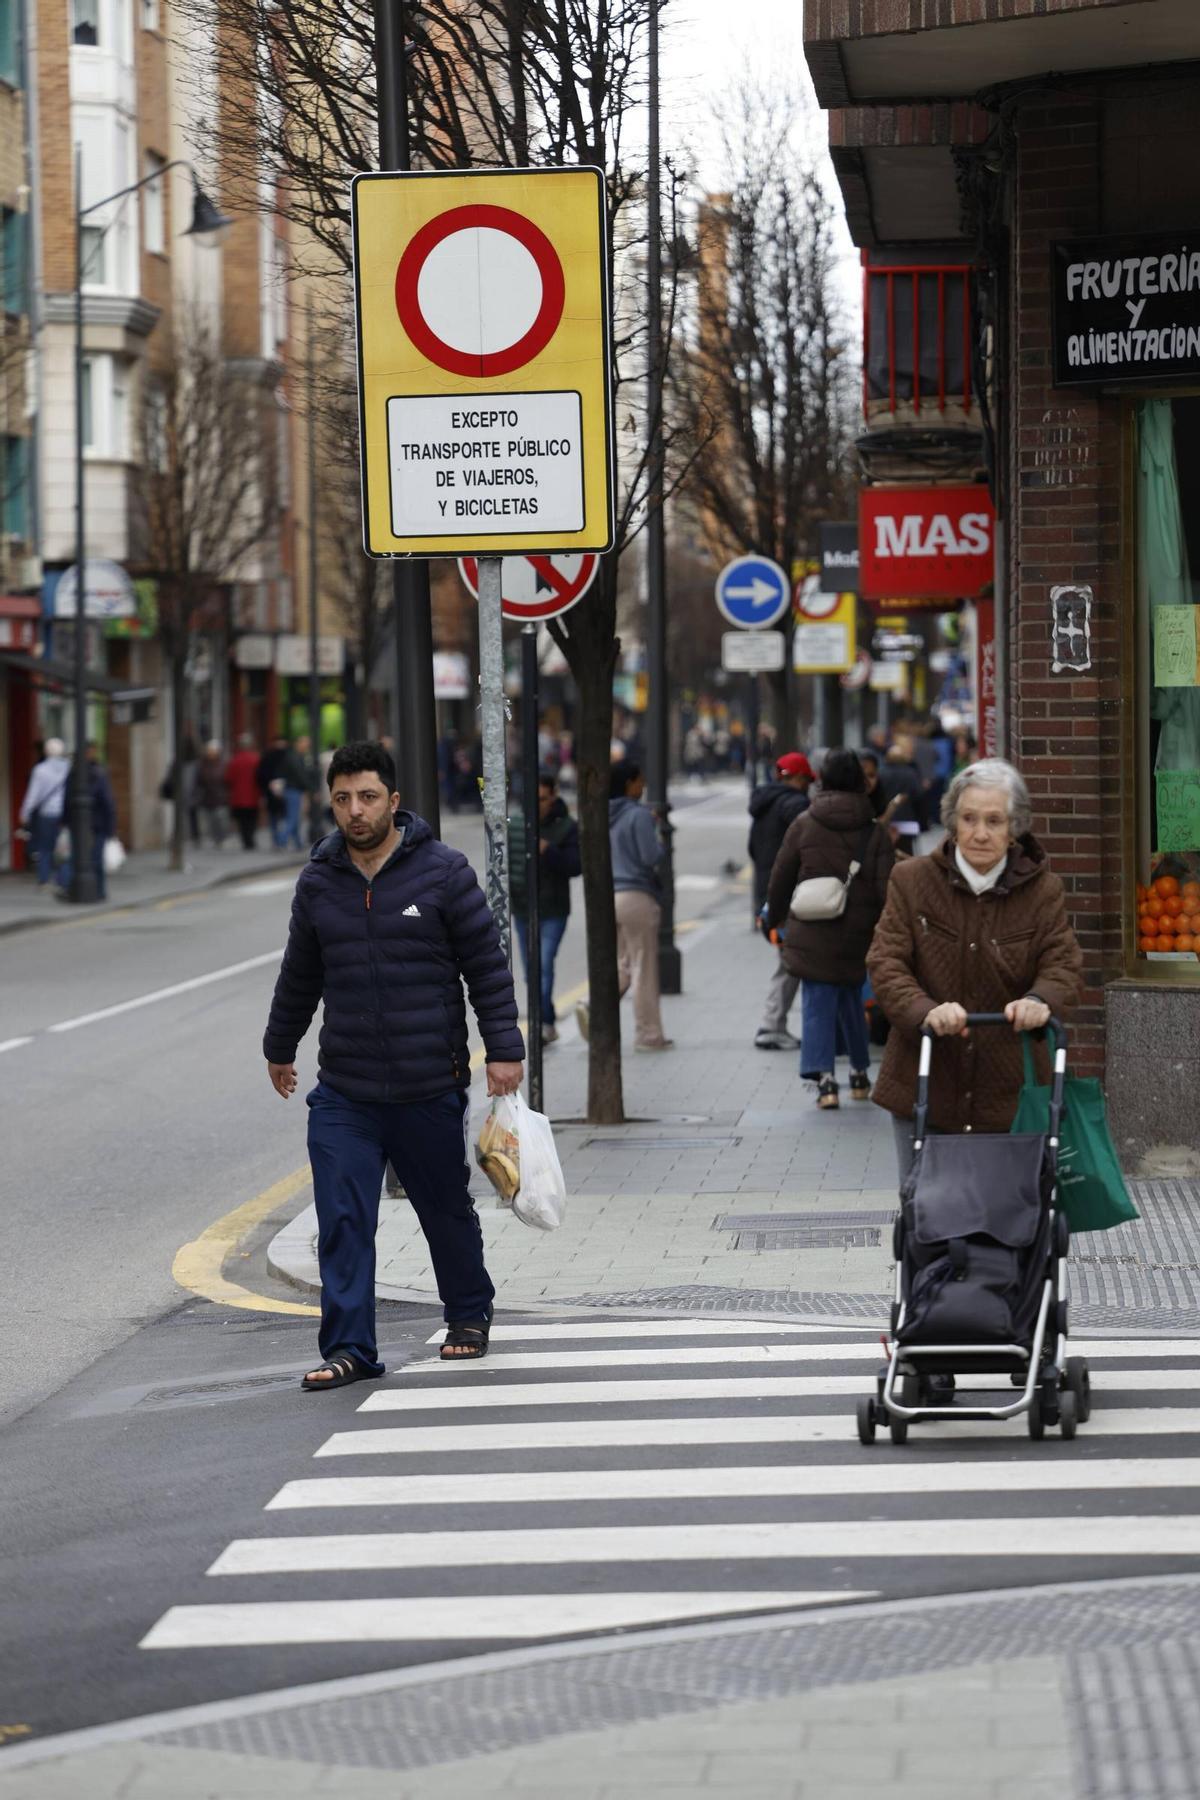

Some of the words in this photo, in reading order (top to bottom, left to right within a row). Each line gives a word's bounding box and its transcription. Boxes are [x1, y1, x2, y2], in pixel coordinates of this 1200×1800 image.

[451, 410, 518, 428] EXCEPTO
[401, 441, 500, 460] TRANSPORTE
[507, 436, 571, 457] PÚBLICO
[436, 470, 455, 487] DE
[463, 468, 538, 487] VIAJEROS,
[438, 500, 447, 516] Y
[455, 497, 538, 516] BICICLETAS
[873, 512, 990, 558] MAS
